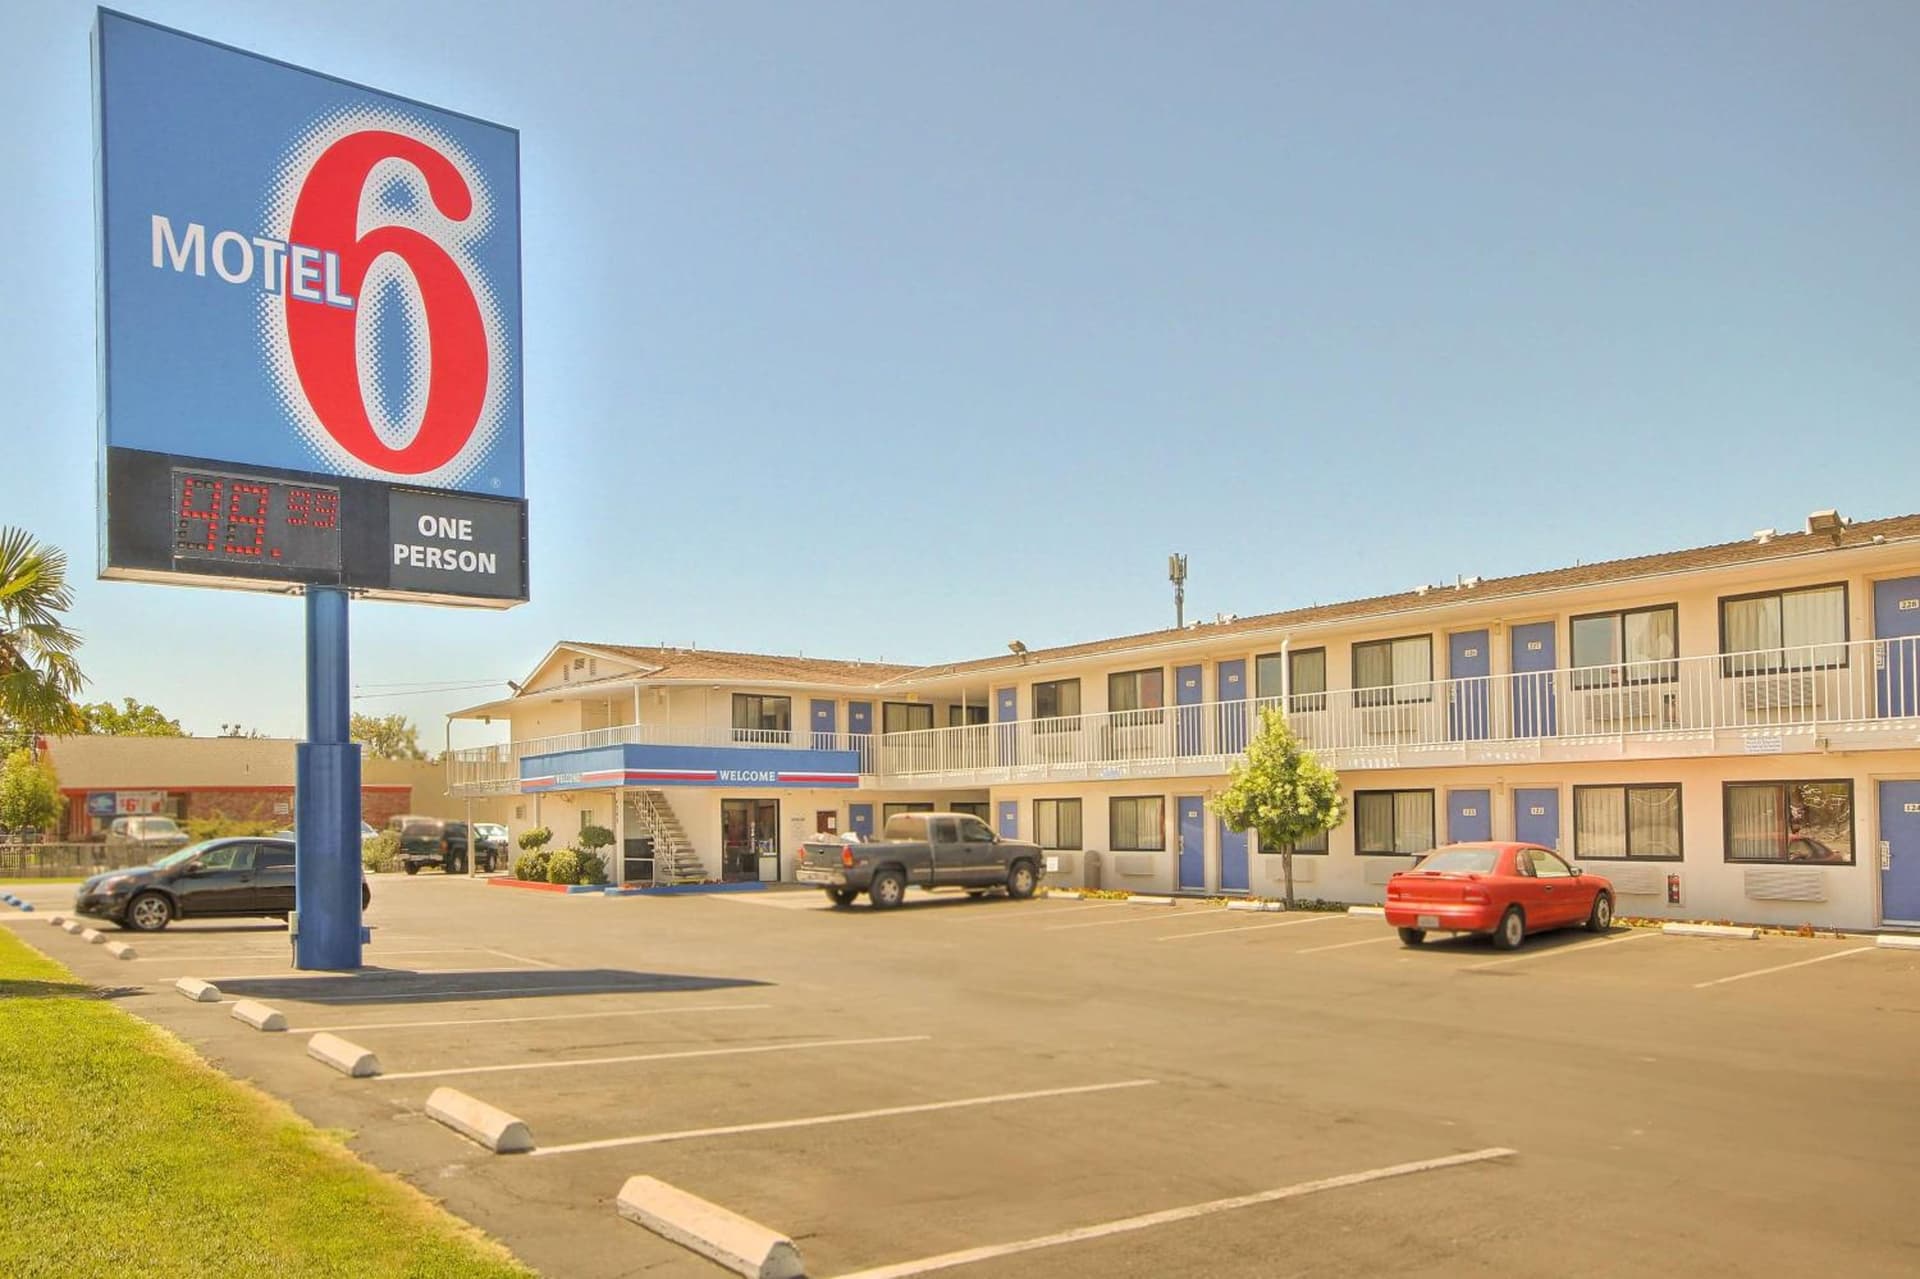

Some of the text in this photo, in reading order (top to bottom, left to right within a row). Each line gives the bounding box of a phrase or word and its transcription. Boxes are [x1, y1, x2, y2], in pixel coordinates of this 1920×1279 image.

[151, 128, 489, 475] MOTEL 6
[417, 514, 473, 541] ONE
[393, 543, 497, 574] PERSON
[720, 770, 776, 782] WELCOME
